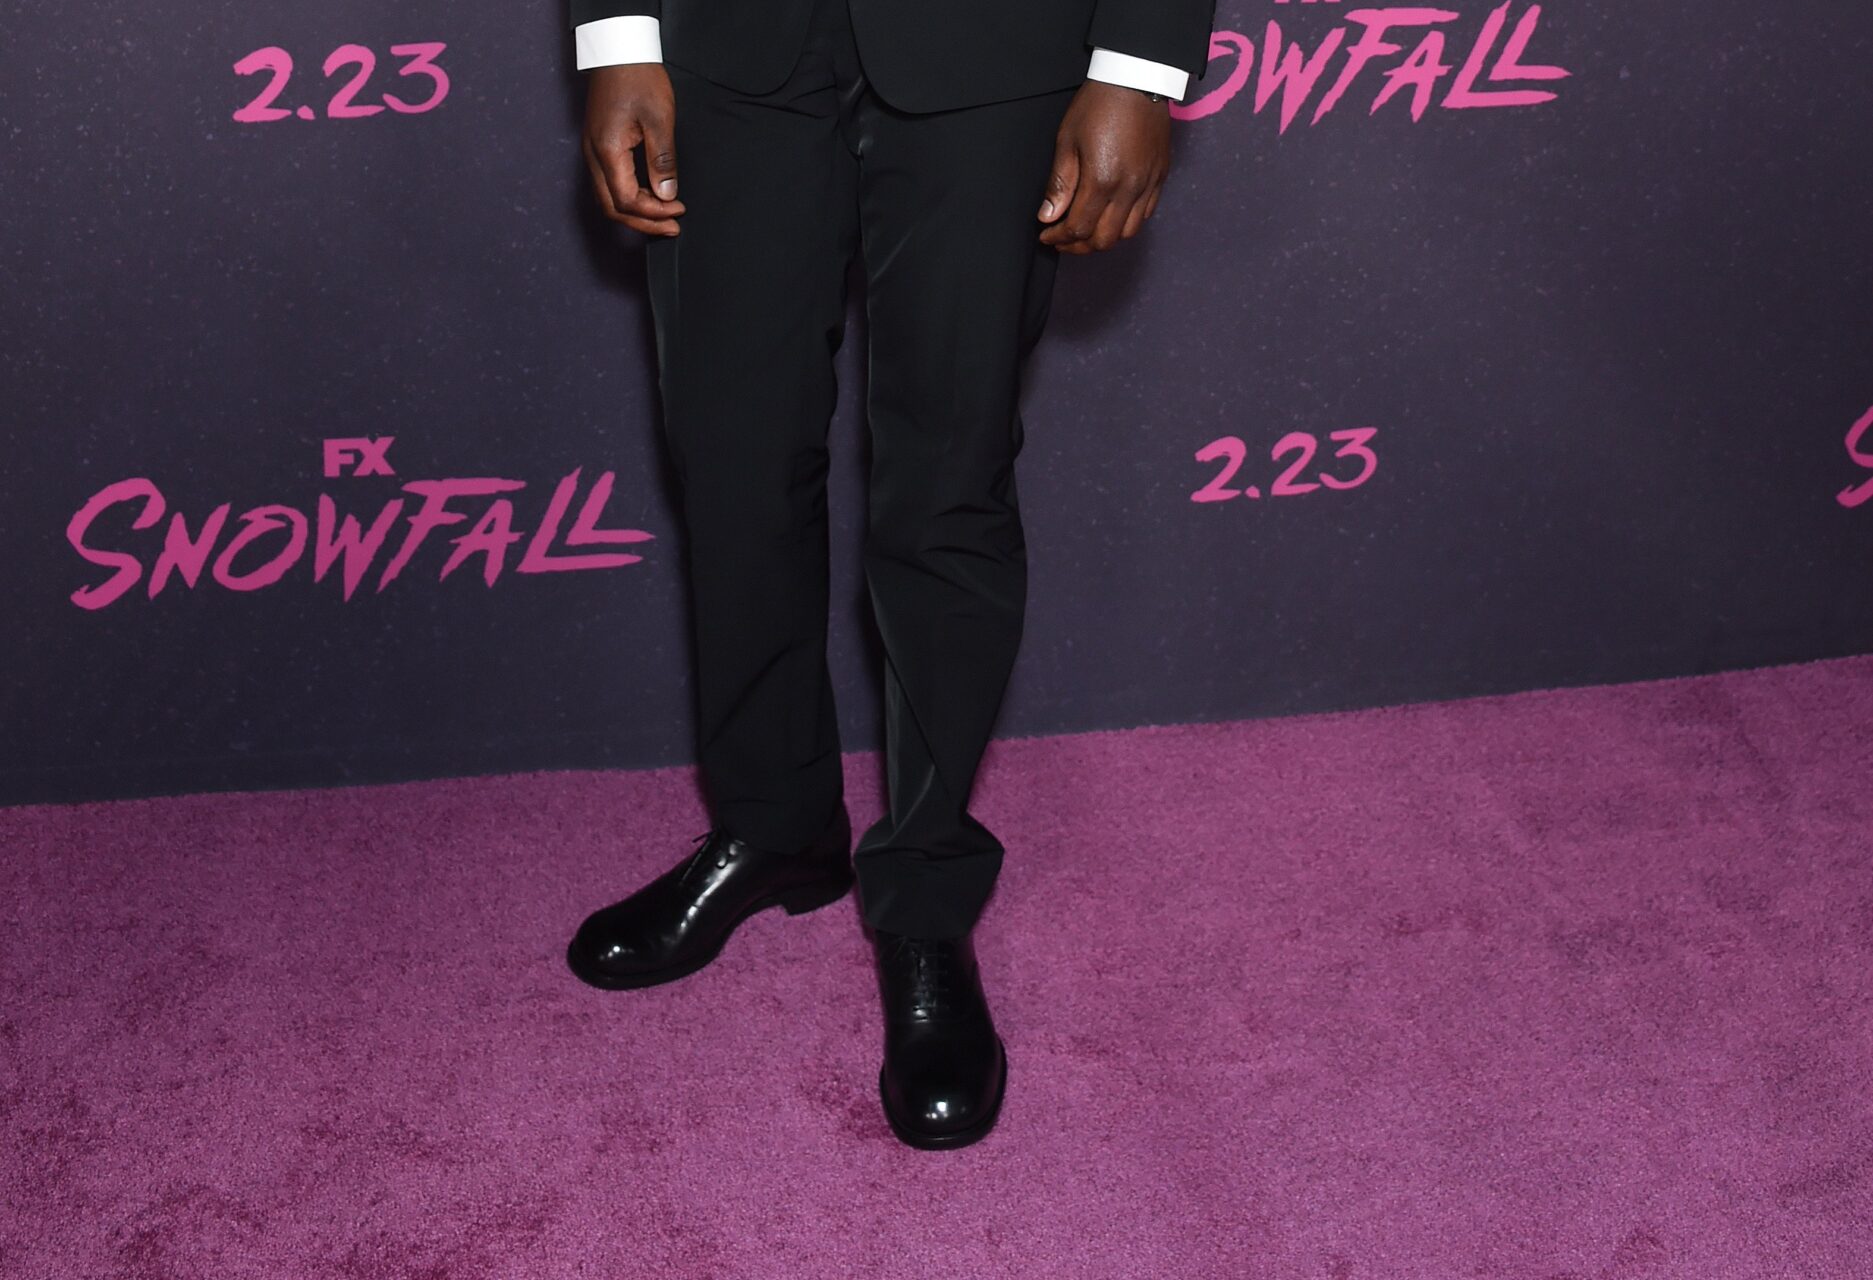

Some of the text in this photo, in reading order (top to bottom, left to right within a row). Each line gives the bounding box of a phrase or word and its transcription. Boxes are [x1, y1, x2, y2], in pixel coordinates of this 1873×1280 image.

[233, 43, 449, 122] 2.23
[324, 437, 394, 477] FX
[1191, 427, 1378, 503] 2.23
[66, 467, 655, 610] SNOWFALL
